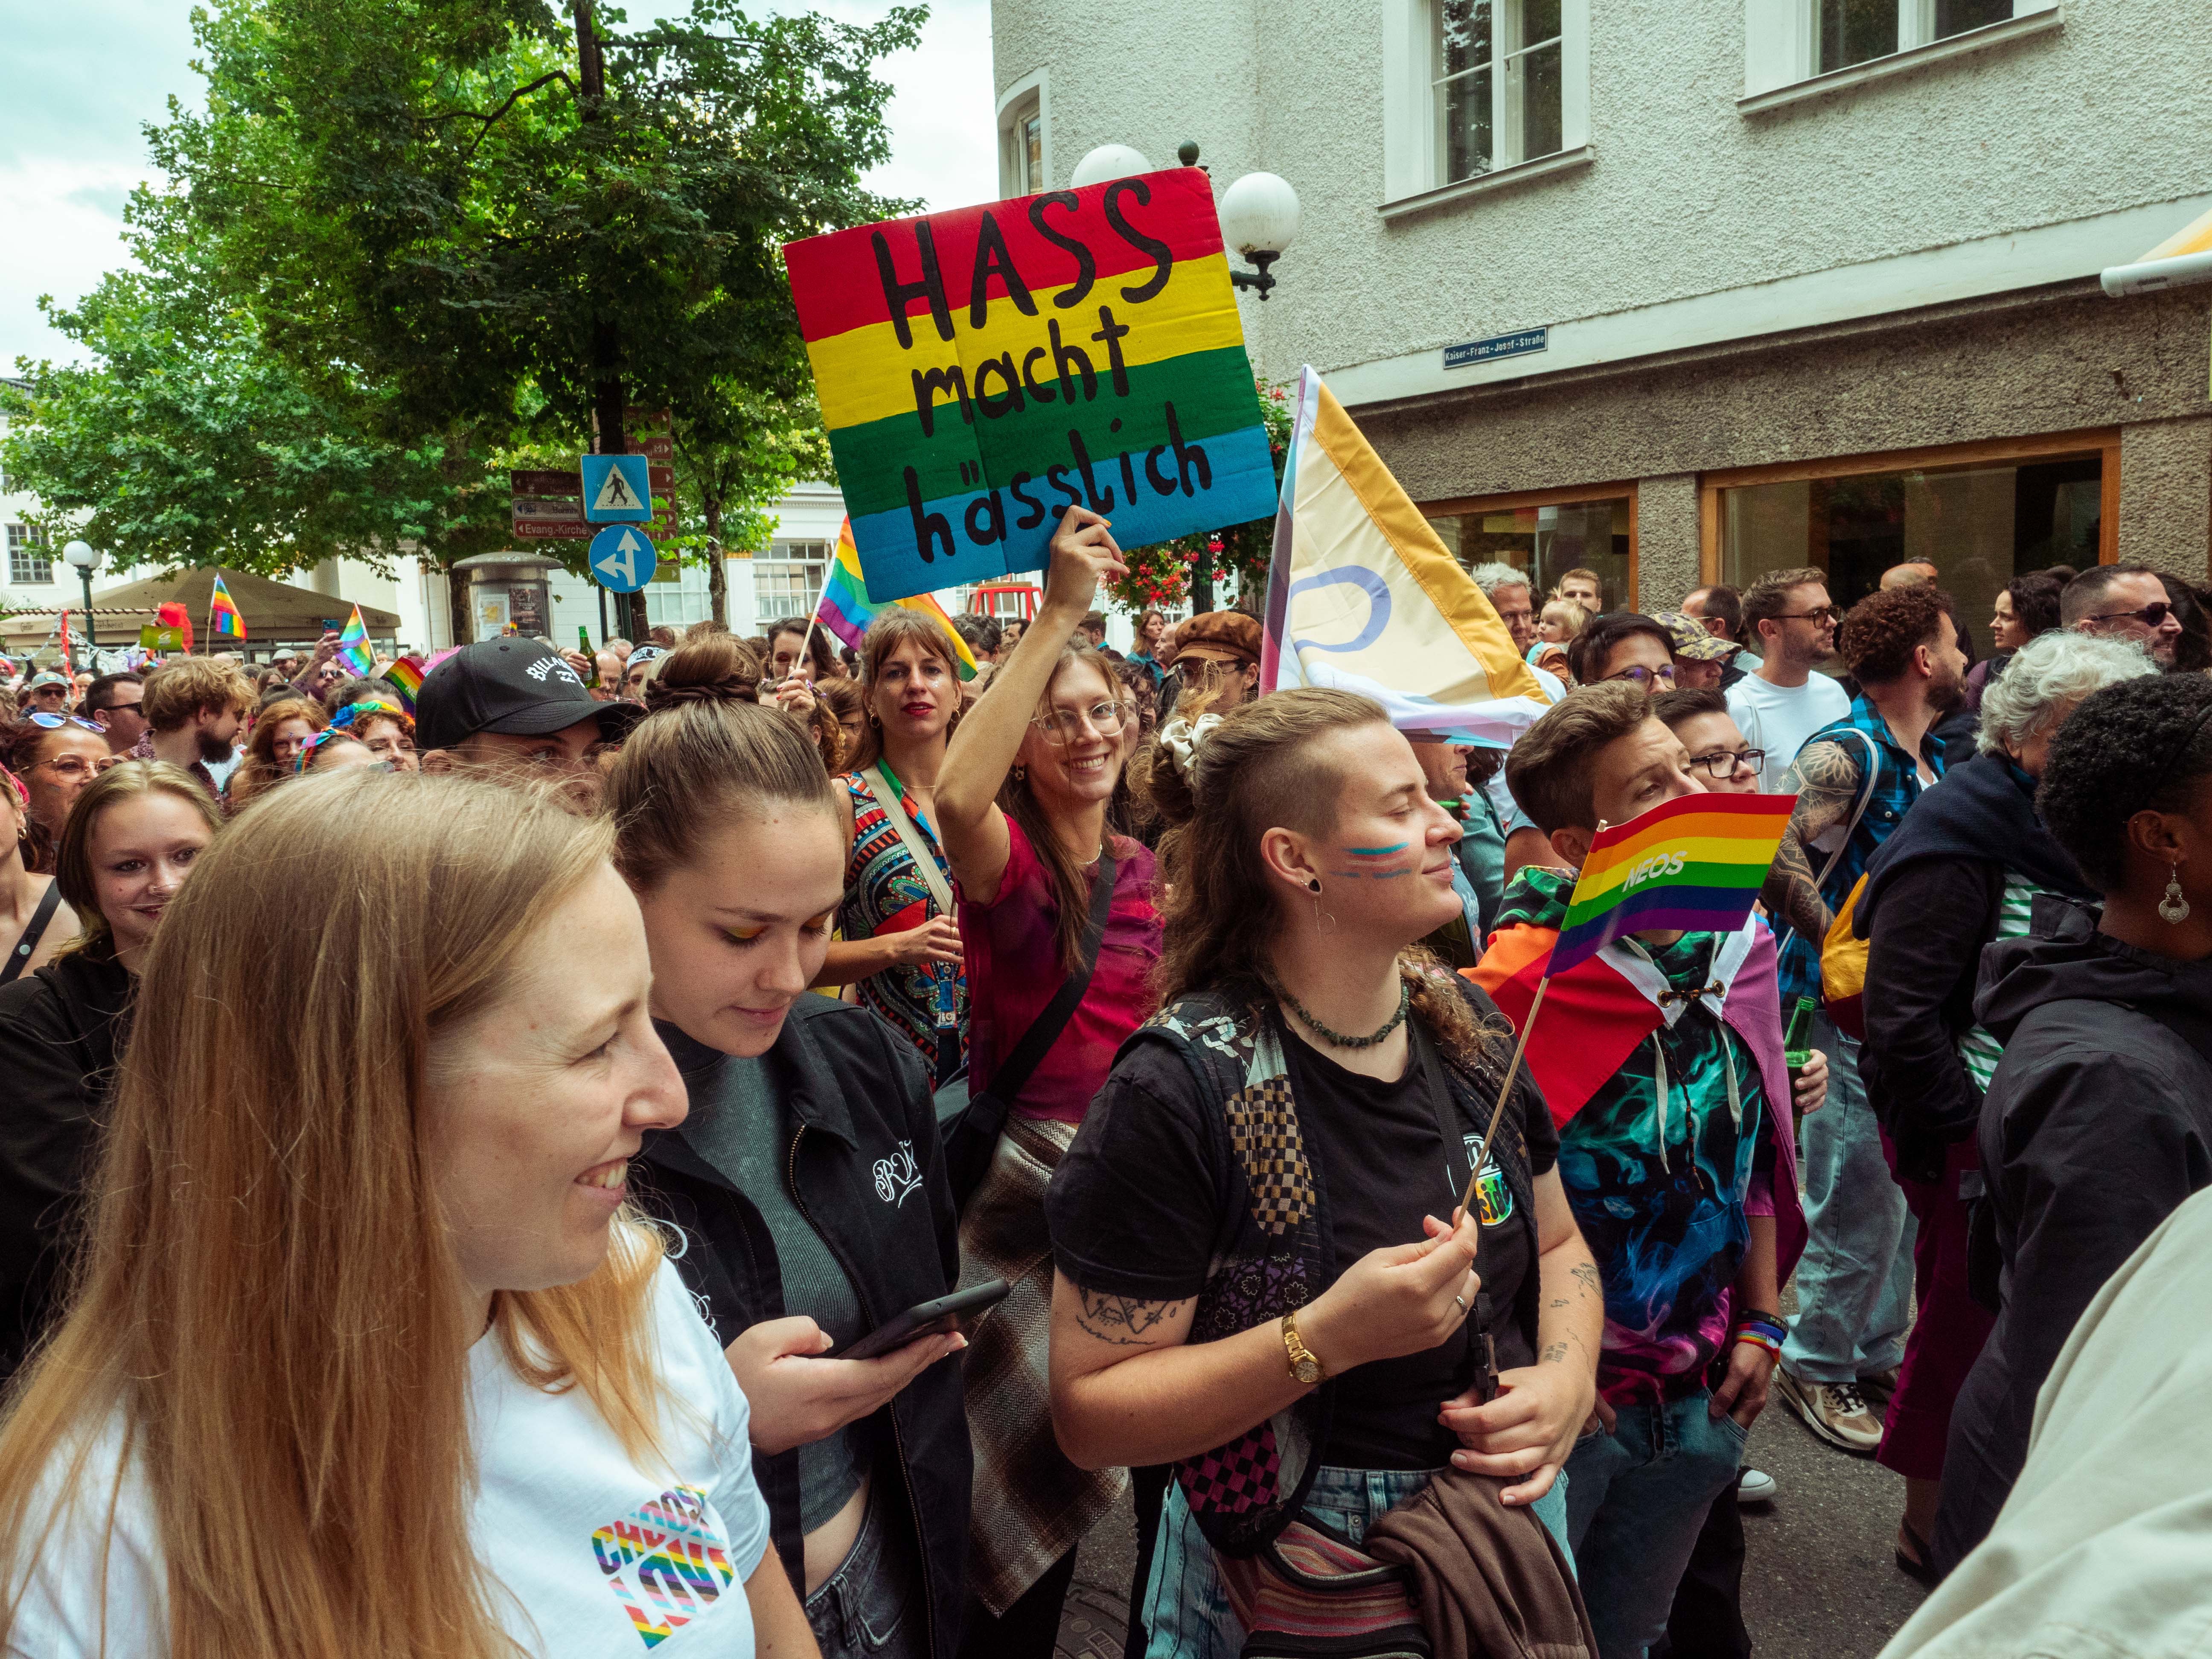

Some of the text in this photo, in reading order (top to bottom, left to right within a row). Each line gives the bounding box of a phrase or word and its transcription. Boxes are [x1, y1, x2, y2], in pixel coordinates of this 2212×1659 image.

[871, 179, 1173, 349] HASS
[1445, 335, 1545, 361] Kaiser-Franz-Josef-Straße
[911, 306, 1129, 437] macht
[903, 401, 1212, 563] hässlich
[525, 524, 587, 536] Evang.-Kirche
[405, 684, 417, 699] NE
[1622, 851, 1688, 892] NEOS
